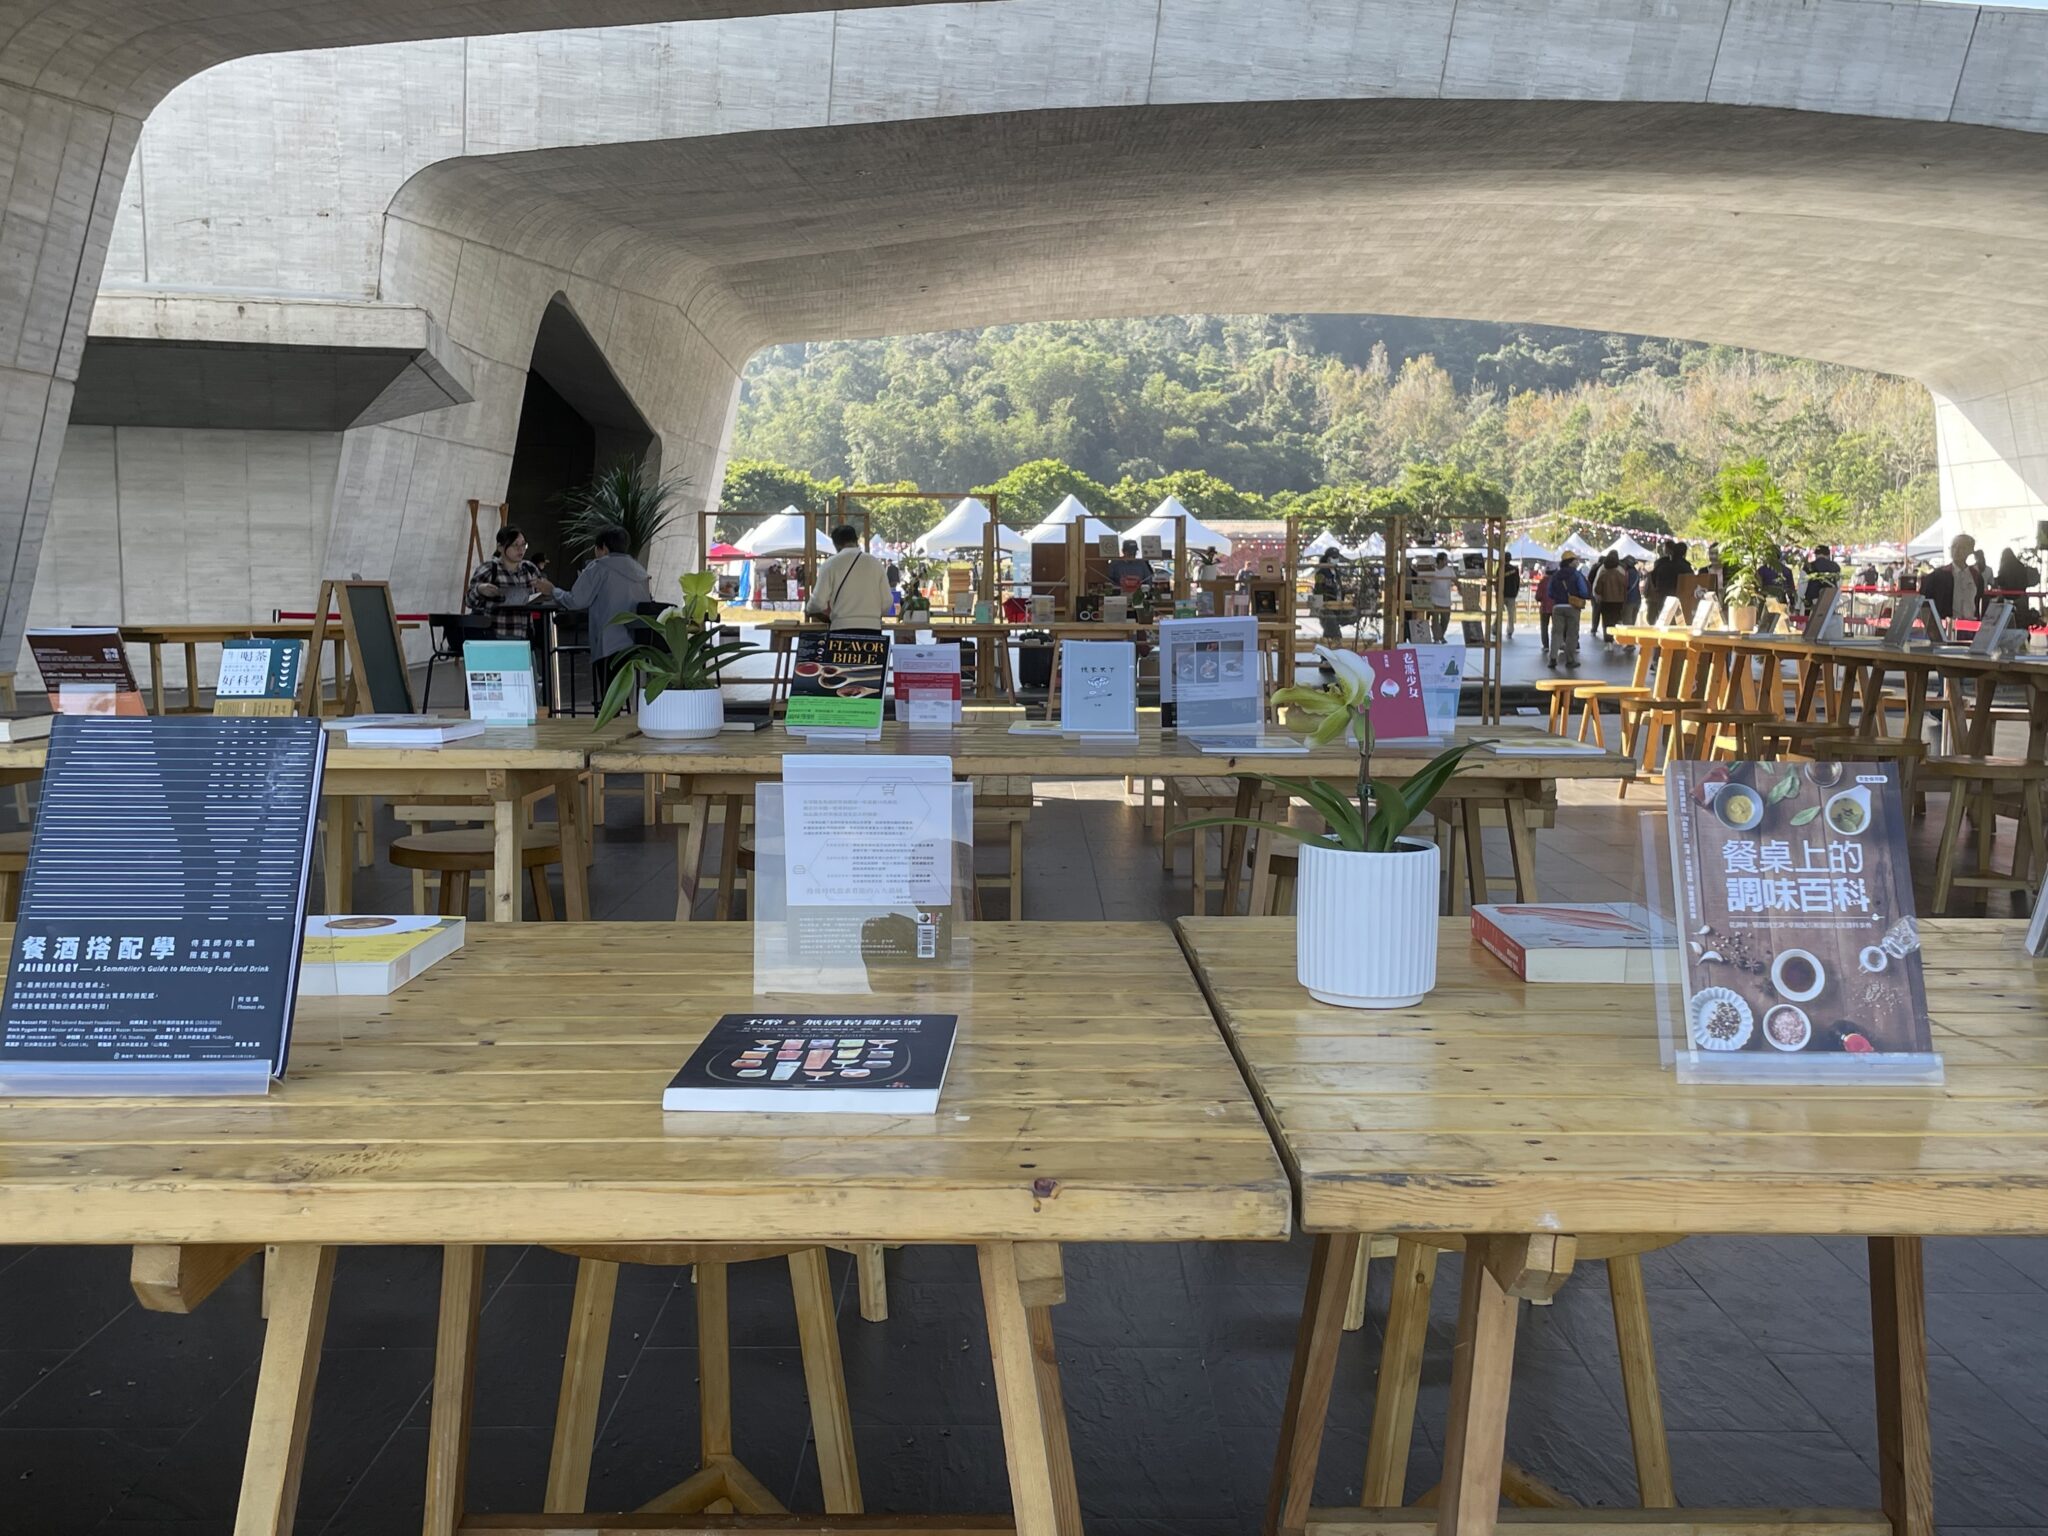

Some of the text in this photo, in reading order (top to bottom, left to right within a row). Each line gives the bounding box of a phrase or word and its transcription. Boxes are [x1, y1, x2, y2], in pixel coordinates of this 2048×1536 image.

[828, 639, 885, 653] FLAVOR
[832, 652, 878, 665] BIBLE
[1402, 652, 1419, 699] 老派少女
[1721, 839, 1864, 874] 餐桌上的
[1725, 877, 1871, 913] 調味百科
[22, 935, 176, 960] 餐酒搭配學
[17, 962, 79, 973] PAIROLOGY
[102, 965, 146, 973] Sommelier's
[147, 965, 169, 973] Guide
[170, 965, 178, 973] to
[180, 965, 213, 974] Matching
[214, 965, 233, 973] Food
[234, 965, 248, 973] and
[249, 965, 270, 973] Drink
